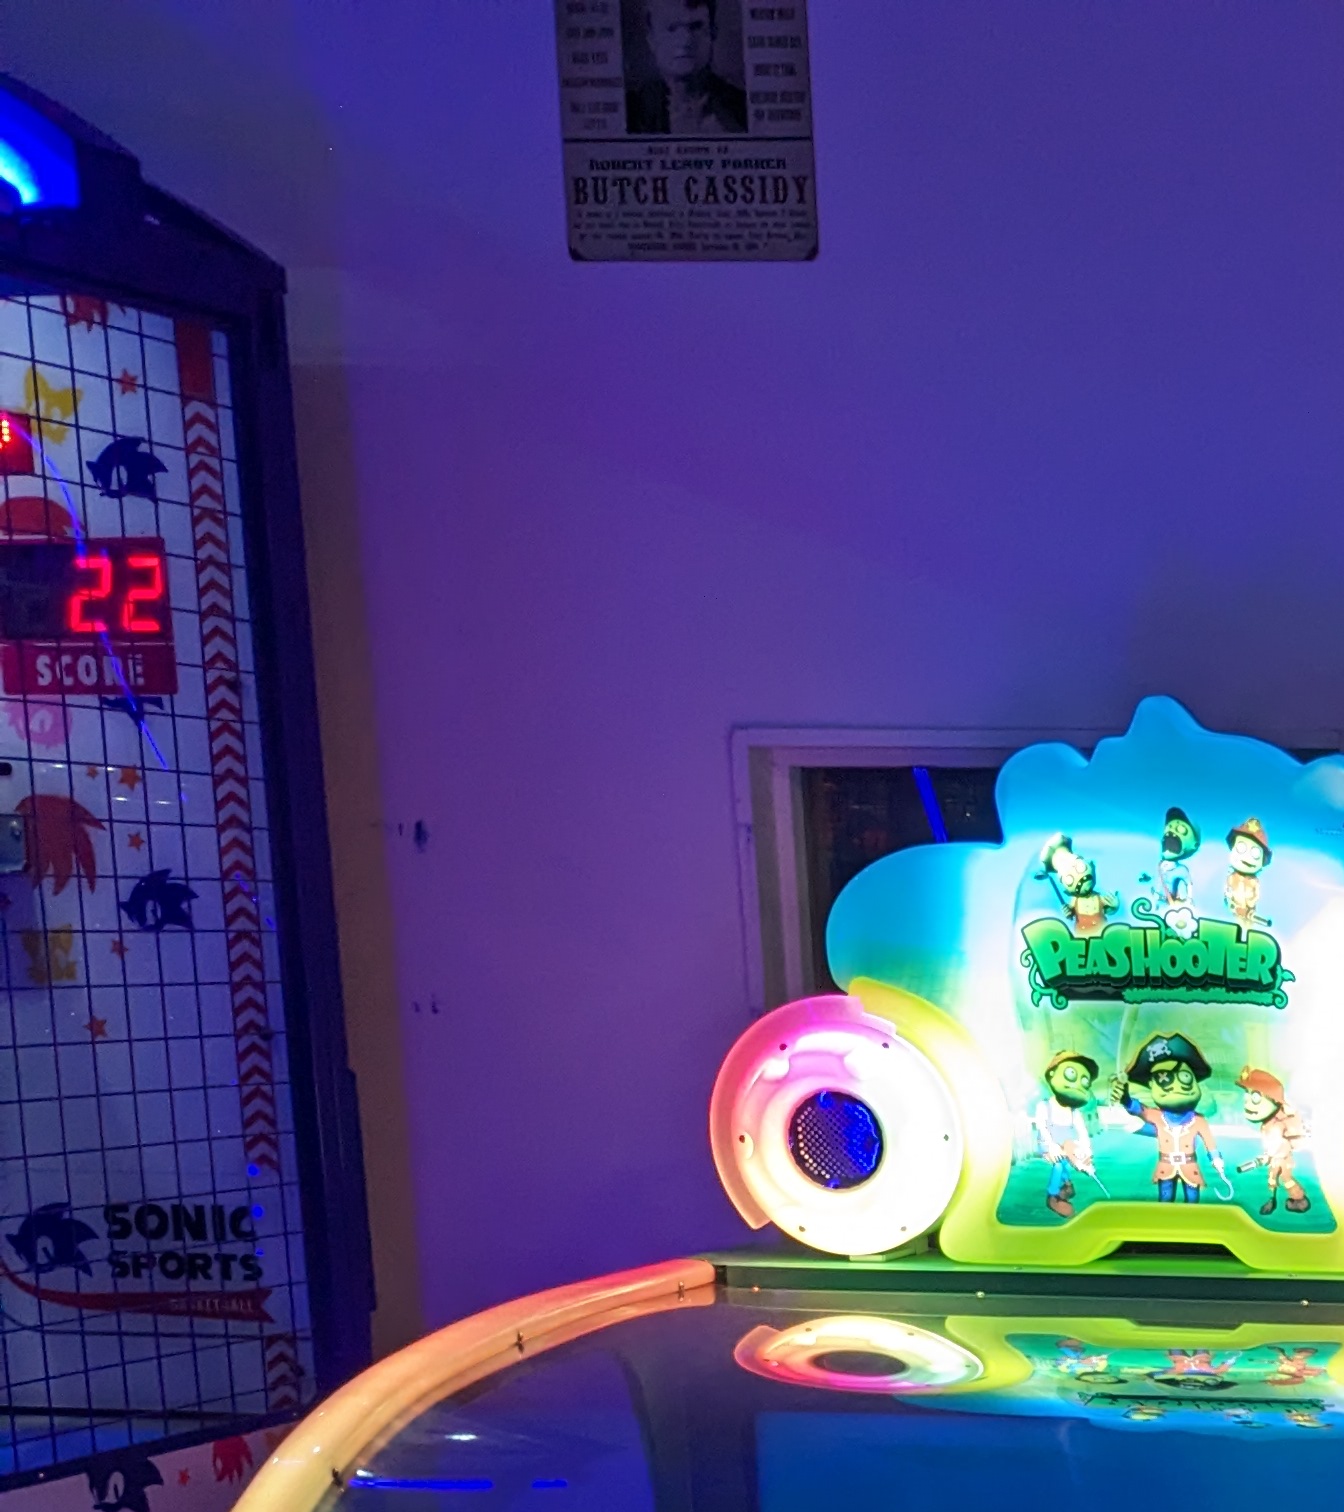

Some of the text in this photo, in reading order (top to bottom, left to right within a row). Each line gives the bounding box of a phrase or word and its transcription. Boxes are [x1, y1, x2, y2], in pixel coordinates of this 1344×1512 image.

[573, 175, 809, 205] BUTCH CASSIDY
[69, 557, 163, 632] 22
[36, 654, 144, 687] SCORE
[1021, 916, 1282, 991] PEASHOOTER
[103, 1203, 259, 1243] SONIC
[107, 1251, 264, 1282] SPORTS
